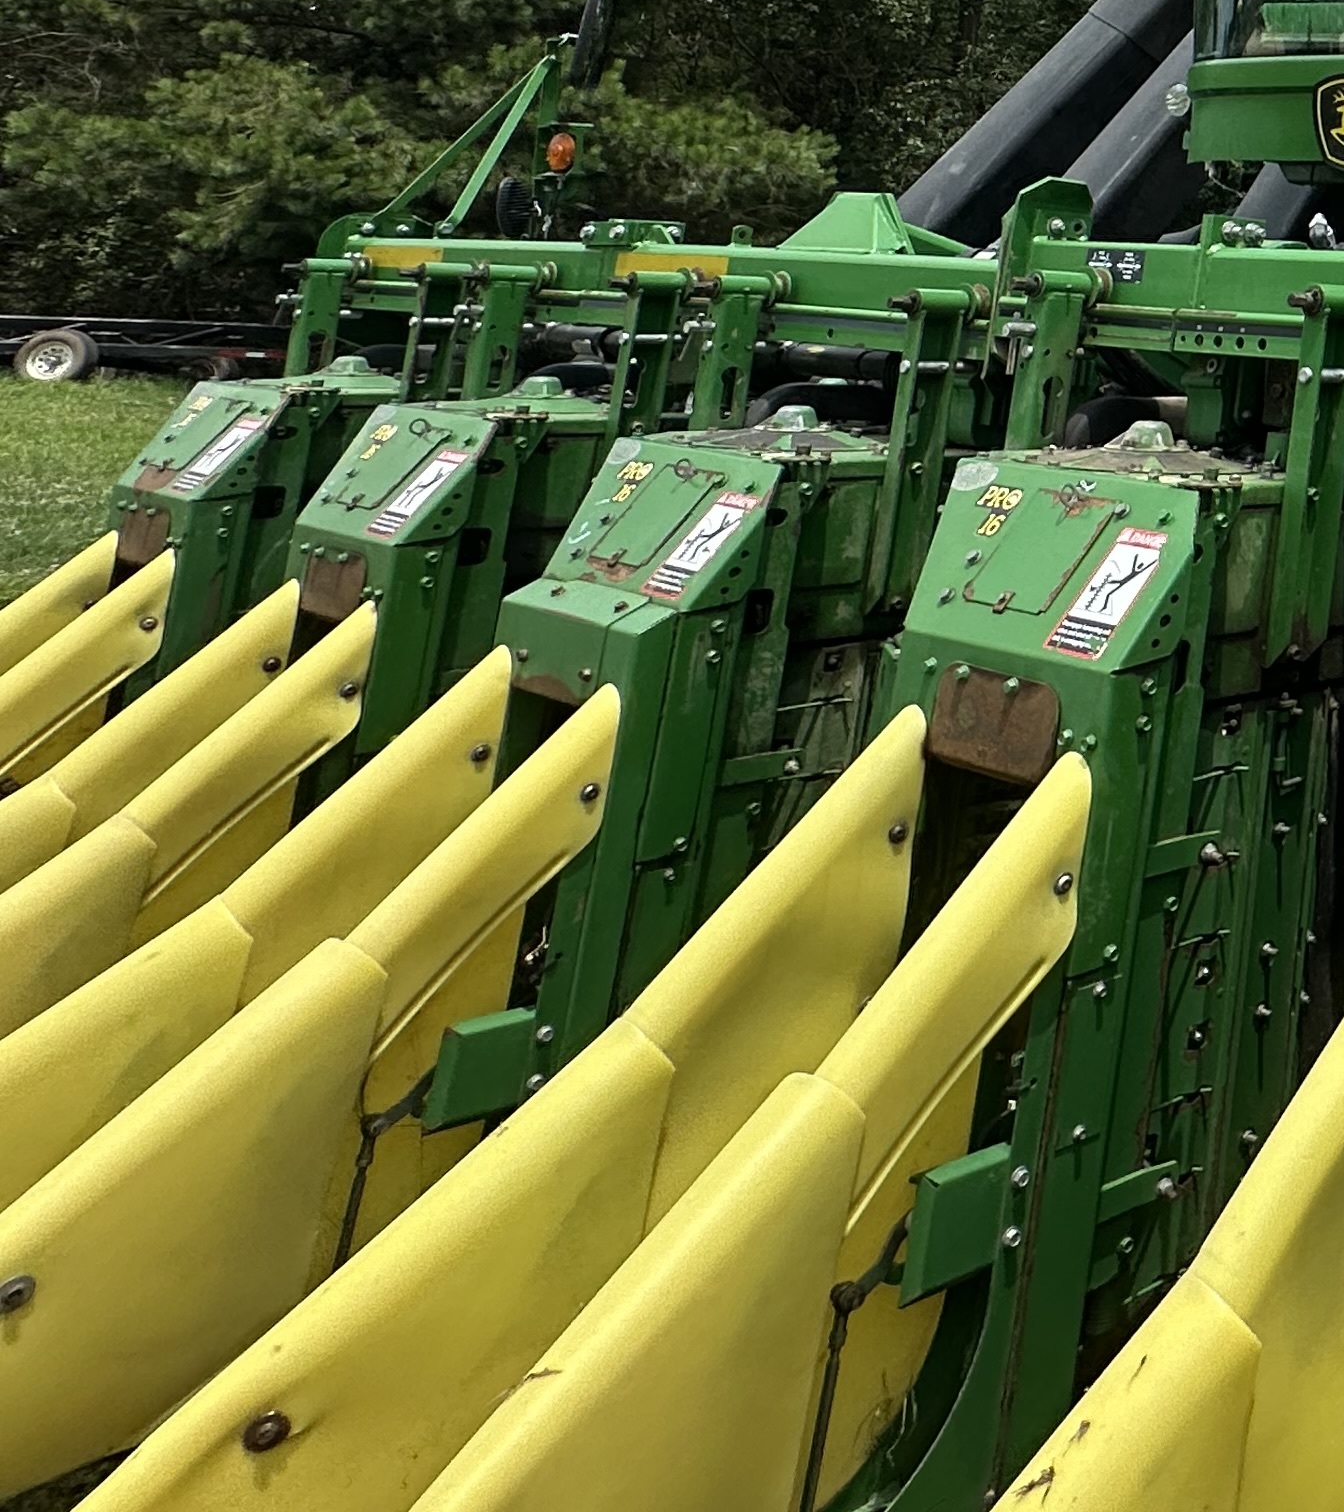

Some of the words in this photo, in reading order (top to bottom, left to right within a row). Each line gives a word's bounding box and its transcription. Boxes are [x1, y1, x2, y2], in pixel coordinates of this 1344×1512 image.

[616, 461, 654, 481] PRO
[611, 484, 637, 503] 16
[976, 485, 1023, 511] PRO
[977, 513, 1006, 536] 16
